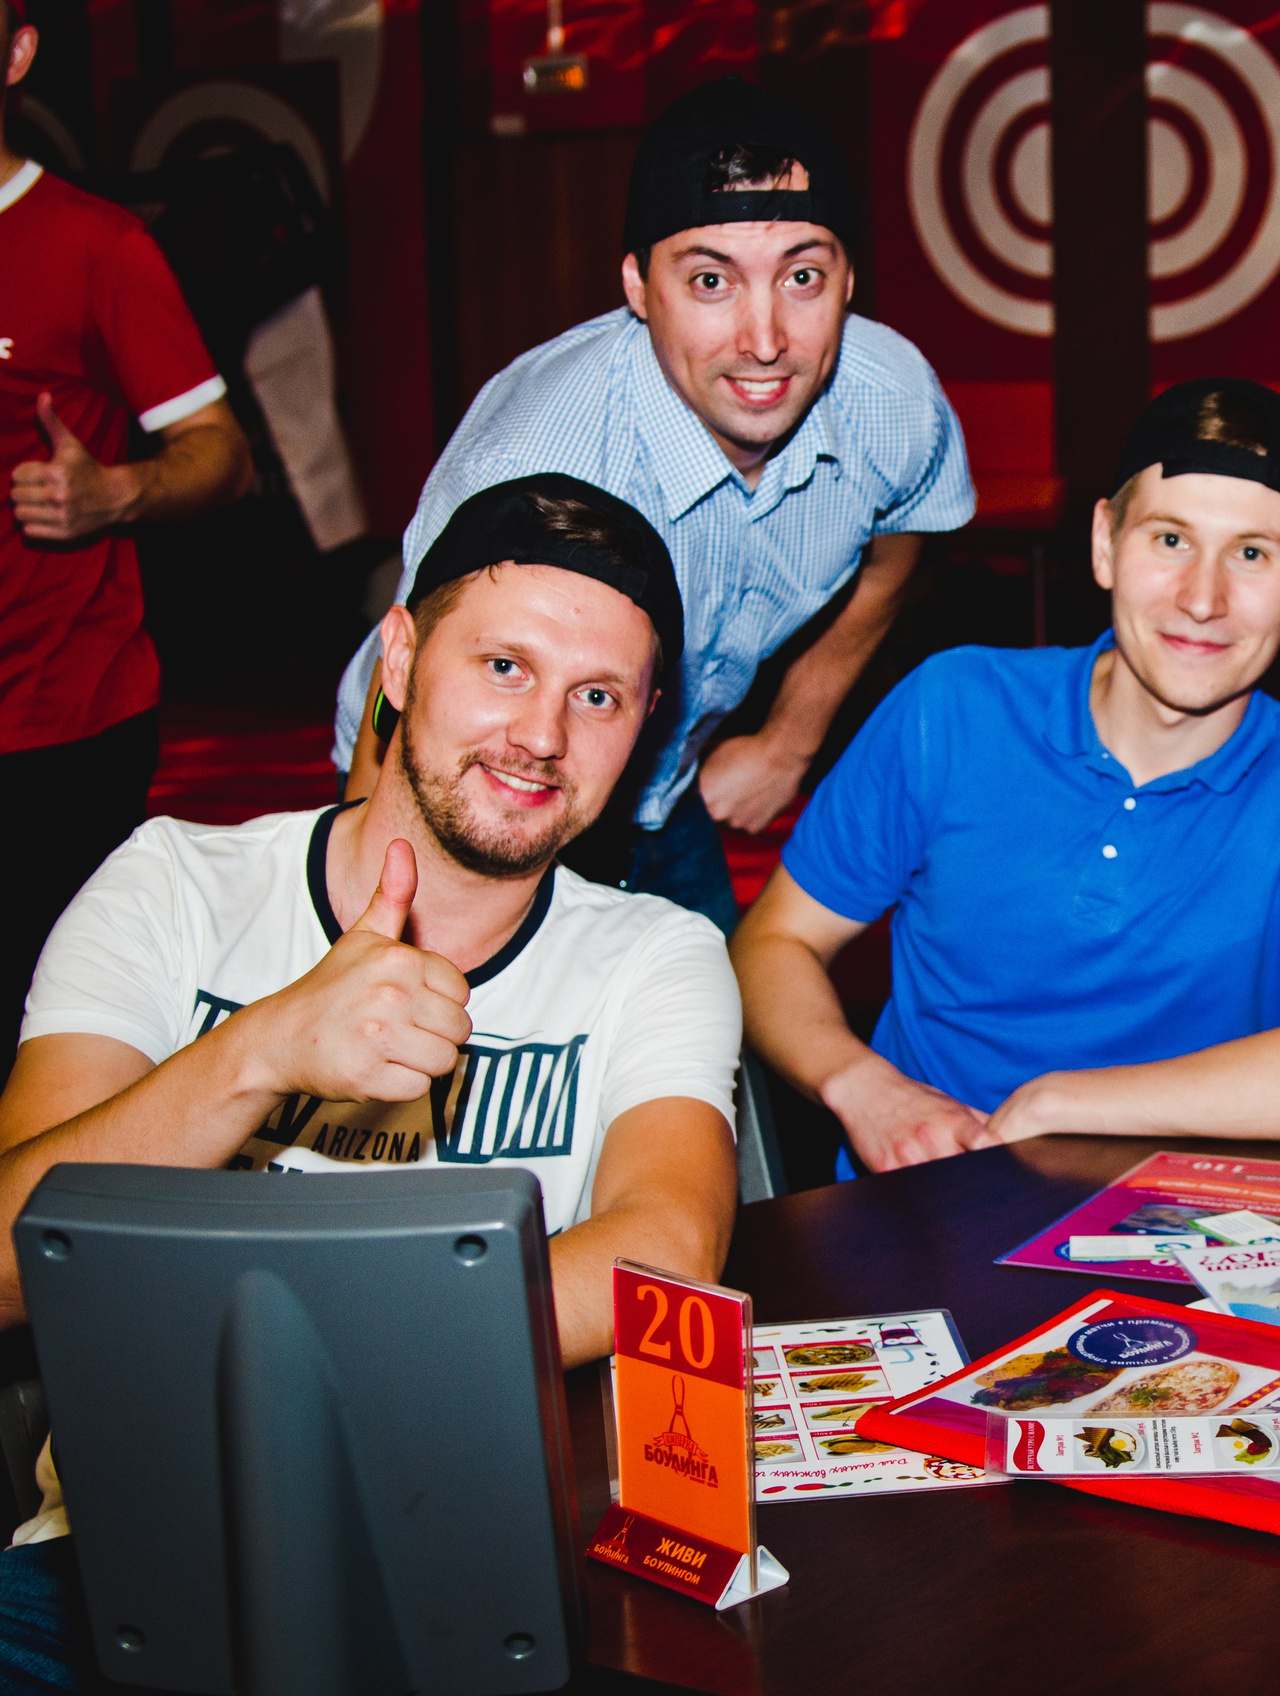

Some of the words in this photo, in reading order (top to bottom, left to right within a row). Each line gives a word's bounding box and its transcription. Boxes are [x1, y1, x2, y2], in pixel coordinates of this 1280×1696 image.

[311, 1121, 422, 1163] ARIZONA
[636, 1283, 716, 1370] 20
[1127, 1319, 1175, 1329] прямые
[644, 1444, 719, 1484] БОУЛИНГА
[770, 1469, 827, 1479] важных
[829, 1462, 875, 1474] самых
[655, 1537, 708, 1569] ЖИВИ
[643, 1554, 702, 1585] БОУЛИНГОМ
